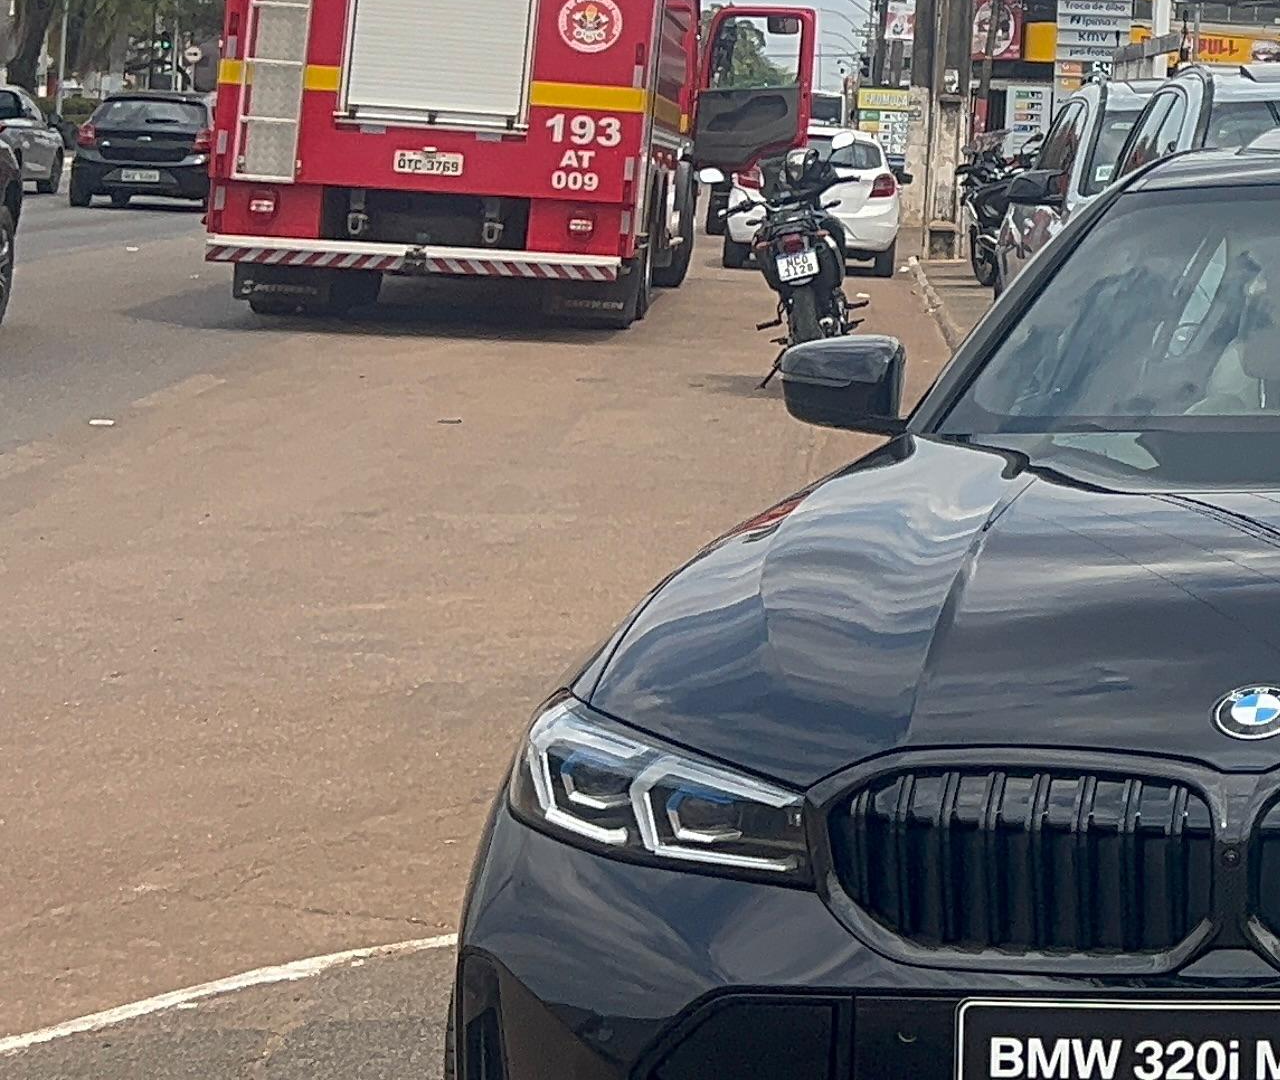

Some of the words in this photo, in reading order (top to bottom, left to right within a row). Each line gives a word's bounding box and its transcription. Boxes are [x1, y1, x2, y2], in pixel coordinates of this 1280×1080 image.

[545, 113, 623, 147] 193
[427, 160, 459, 173] 3769
[560, 149, 596, 169] AT
[551, 172, 600, 191] 009
[990, 1038, 1122, 1080] BMW
[1134, 1038, 1241, 1080] 320i
